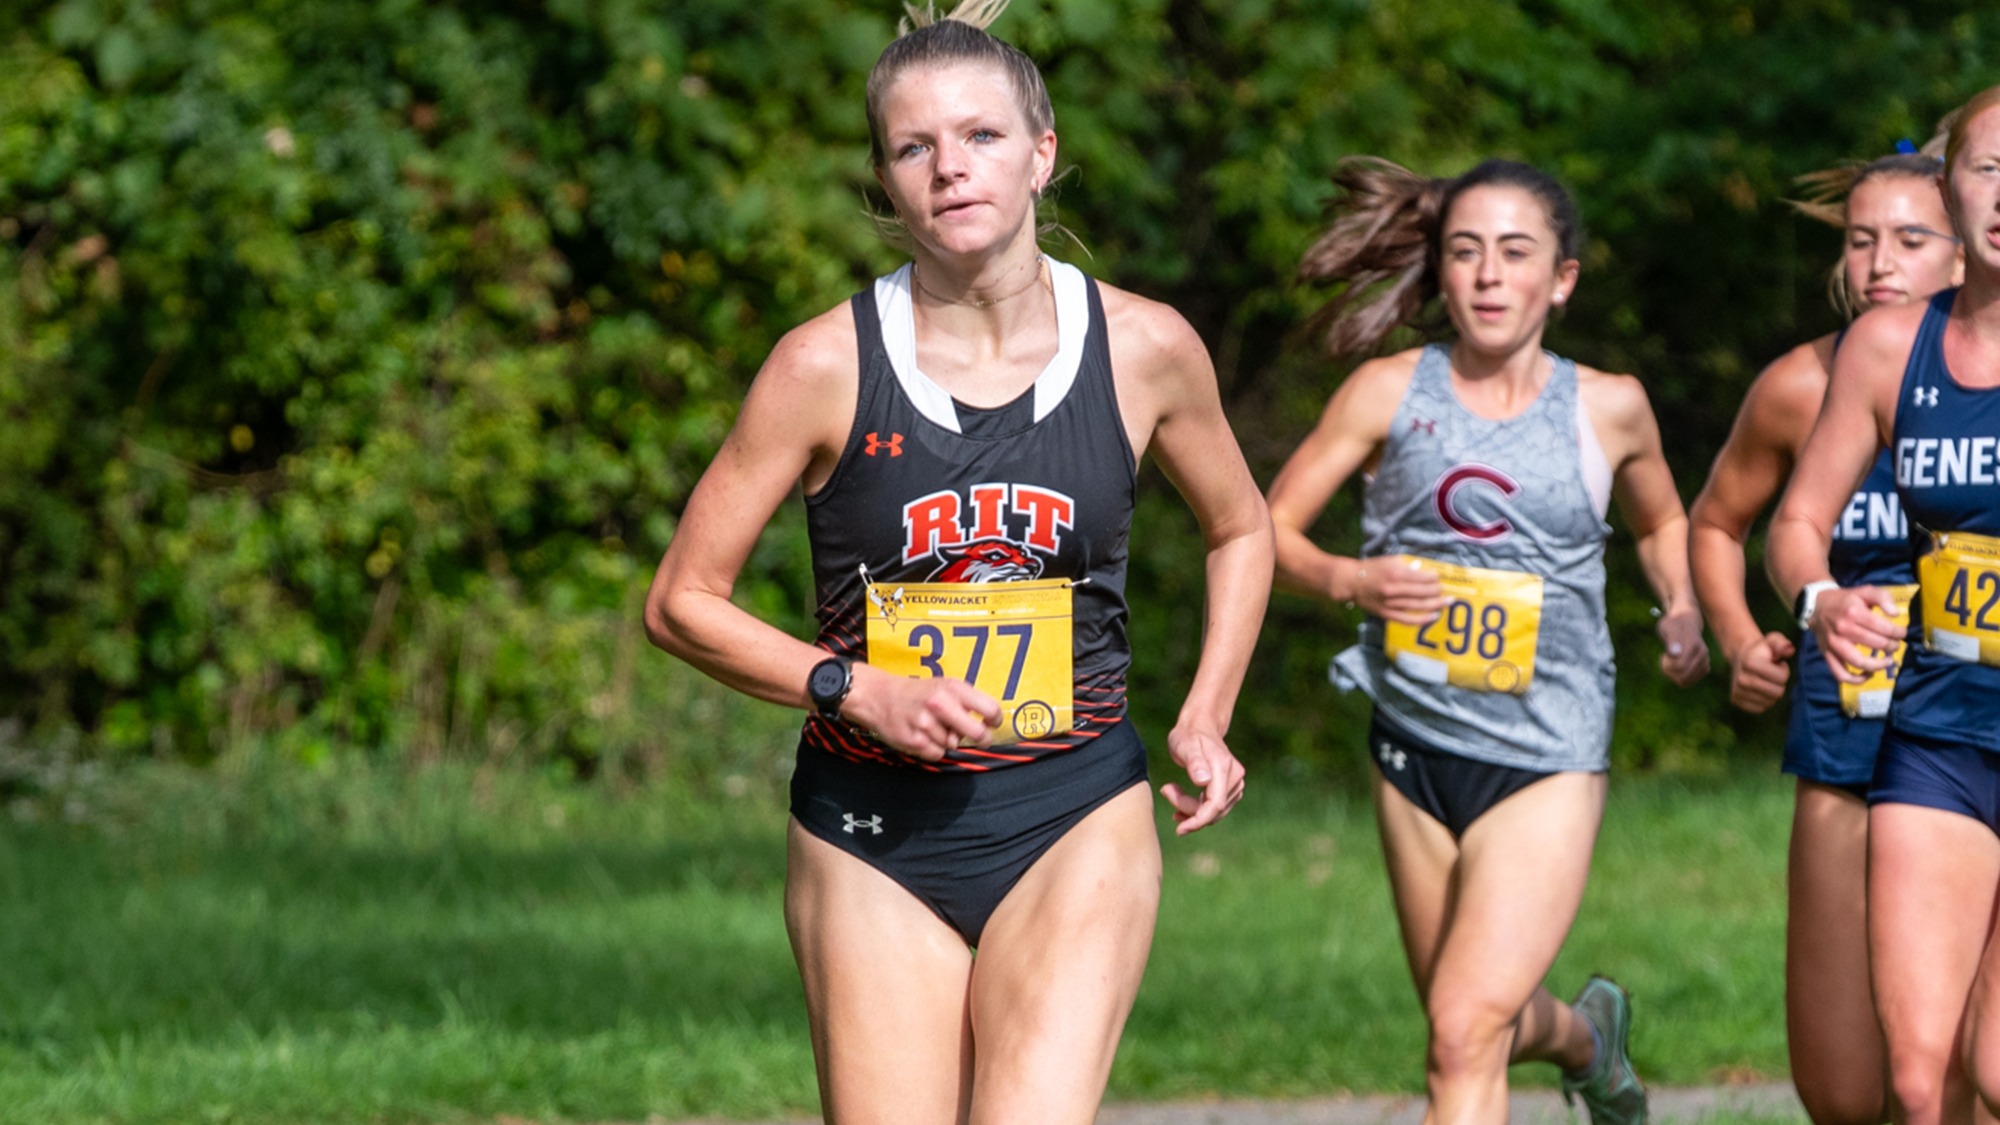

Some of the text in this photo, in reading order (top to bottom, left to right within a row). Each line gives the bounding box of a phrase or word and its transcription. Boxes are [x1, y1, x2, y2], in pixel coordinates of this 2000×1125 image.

[1896, 436, 2000, 487] GENE
[902, 482, 1075, 566] RIT
[1431, 461, 1523, 544] C
[904, 595, 988, 605] YELLOWJACKET
[908, 623, 1033, 701] 377
